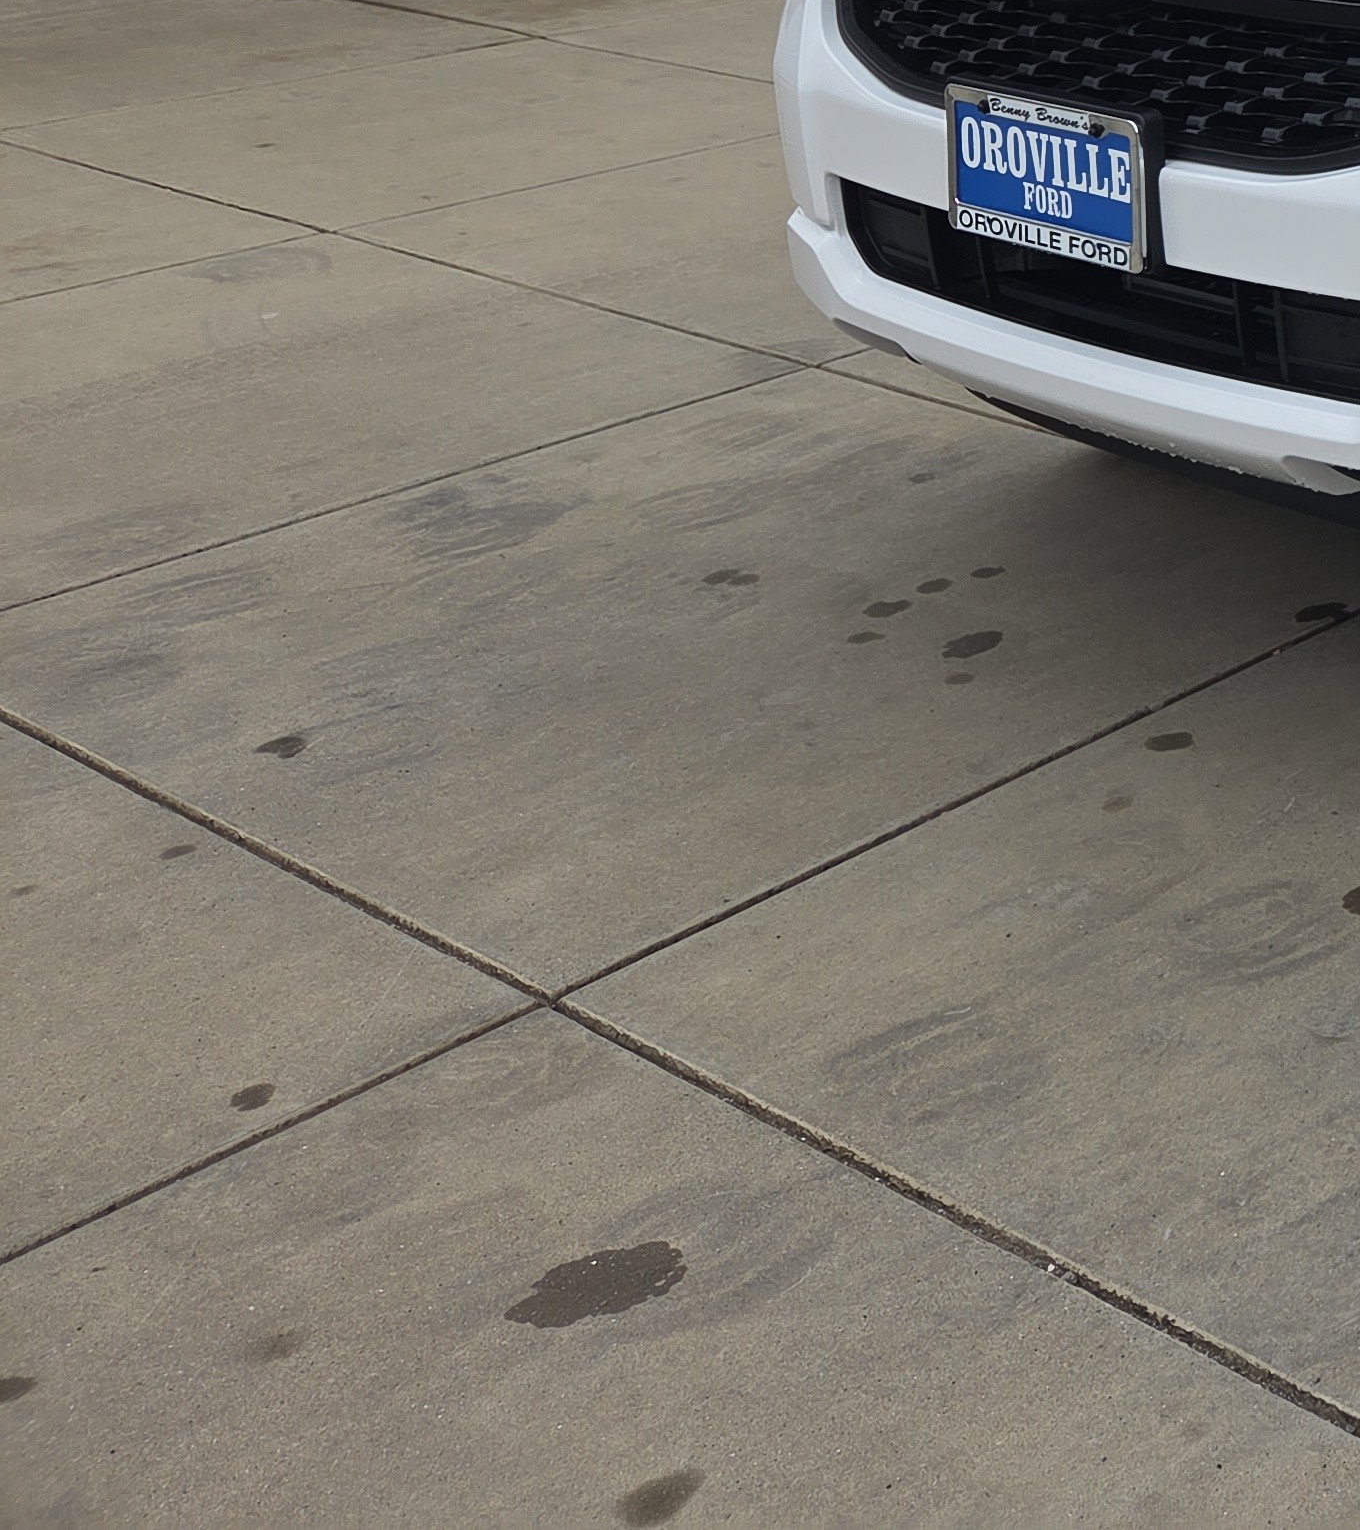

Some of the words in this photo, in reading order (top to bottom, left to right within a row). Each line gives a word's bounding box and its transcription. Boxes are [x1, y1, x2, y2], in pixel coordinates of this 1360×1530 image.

[989, 98, 1031, 121] Benny
[1035, 107, 1090, 131] Brown's
[961, 116, 1131, 204] OROVILLE
[1022, 181, 1073, 220] FORD
[958, 209, 1062, 251] OROVILLE
[1068, 235, 1128, 267] FORD
